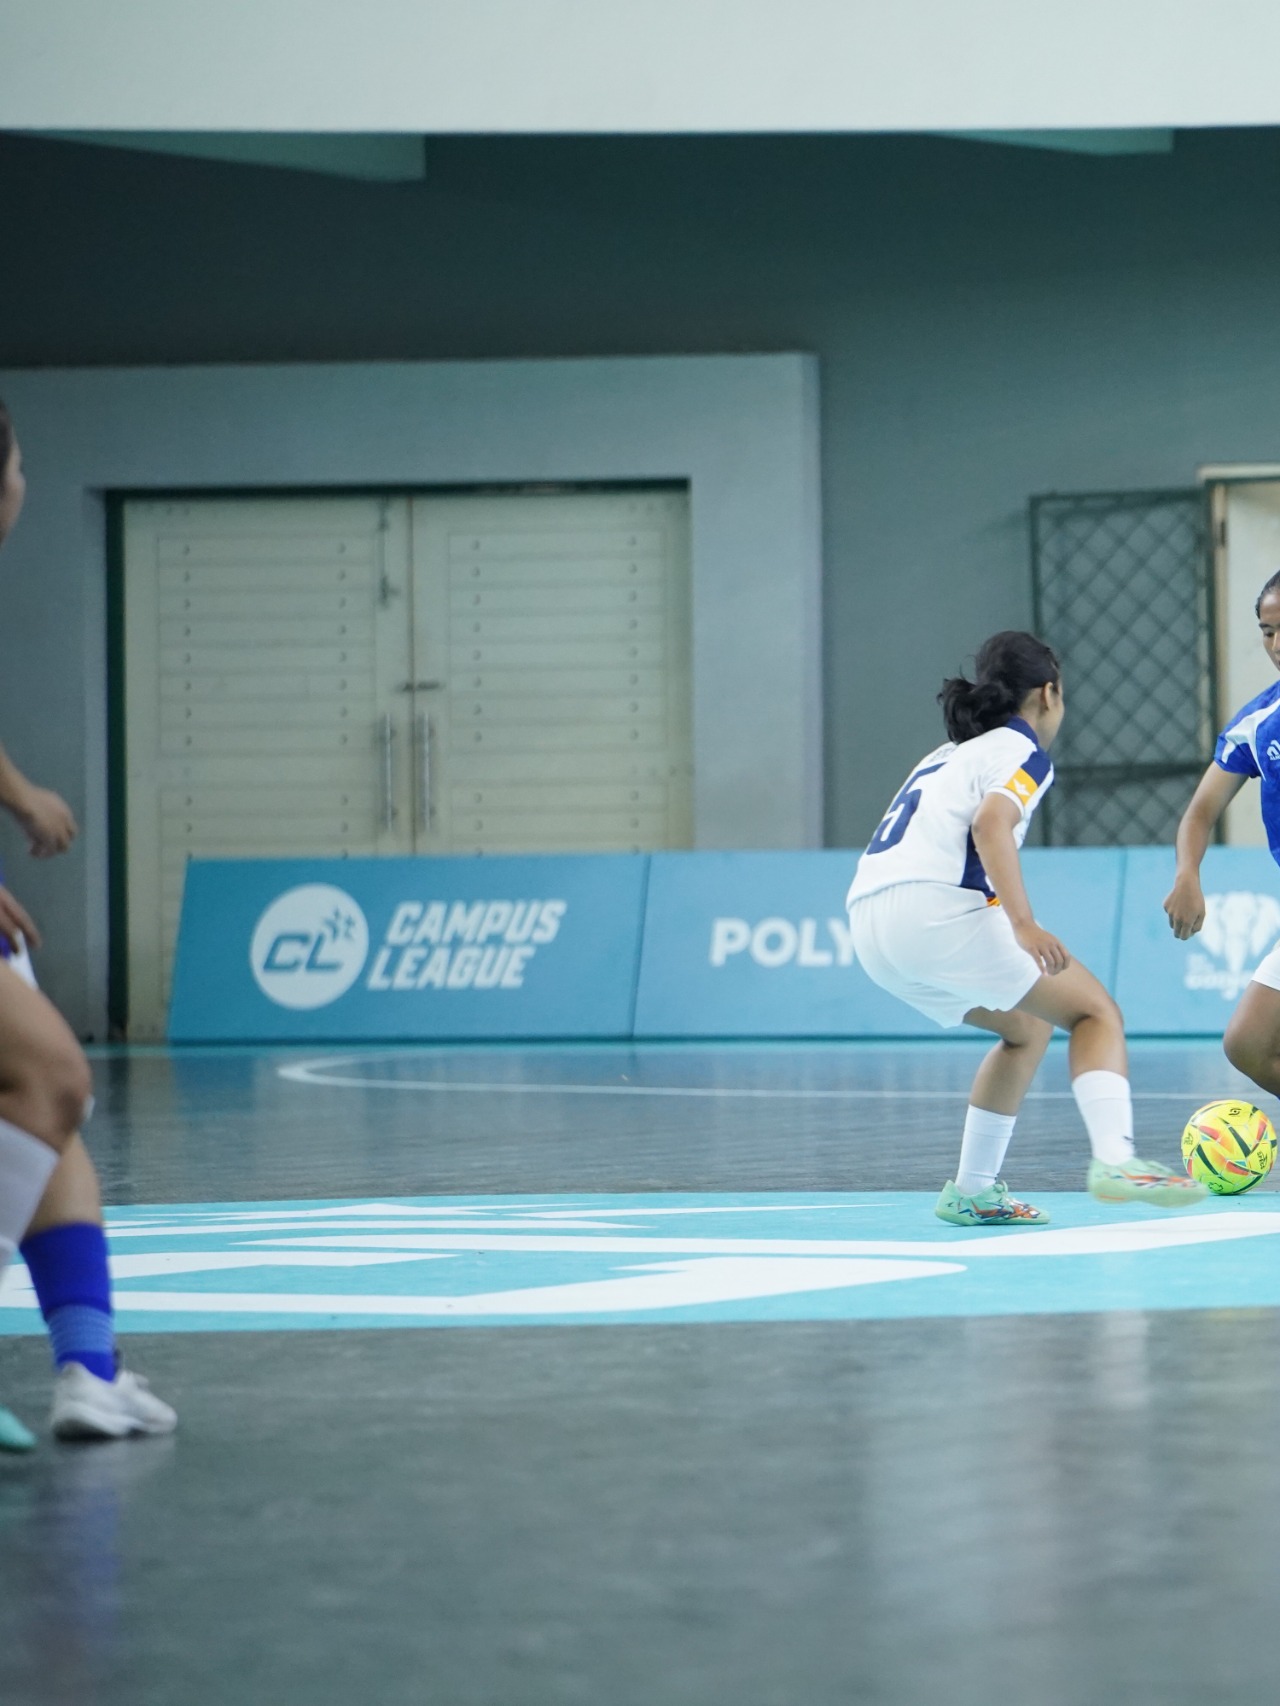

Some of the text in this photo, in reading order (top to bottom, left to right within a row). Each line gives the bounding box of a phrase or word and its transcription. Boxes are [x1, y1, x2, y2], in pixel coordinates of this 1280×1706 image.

[387, 901, 567, 945] CAMPUS
[263, 934, 343, 973] CL
[367, 946, 536, 990] LEAGUE
